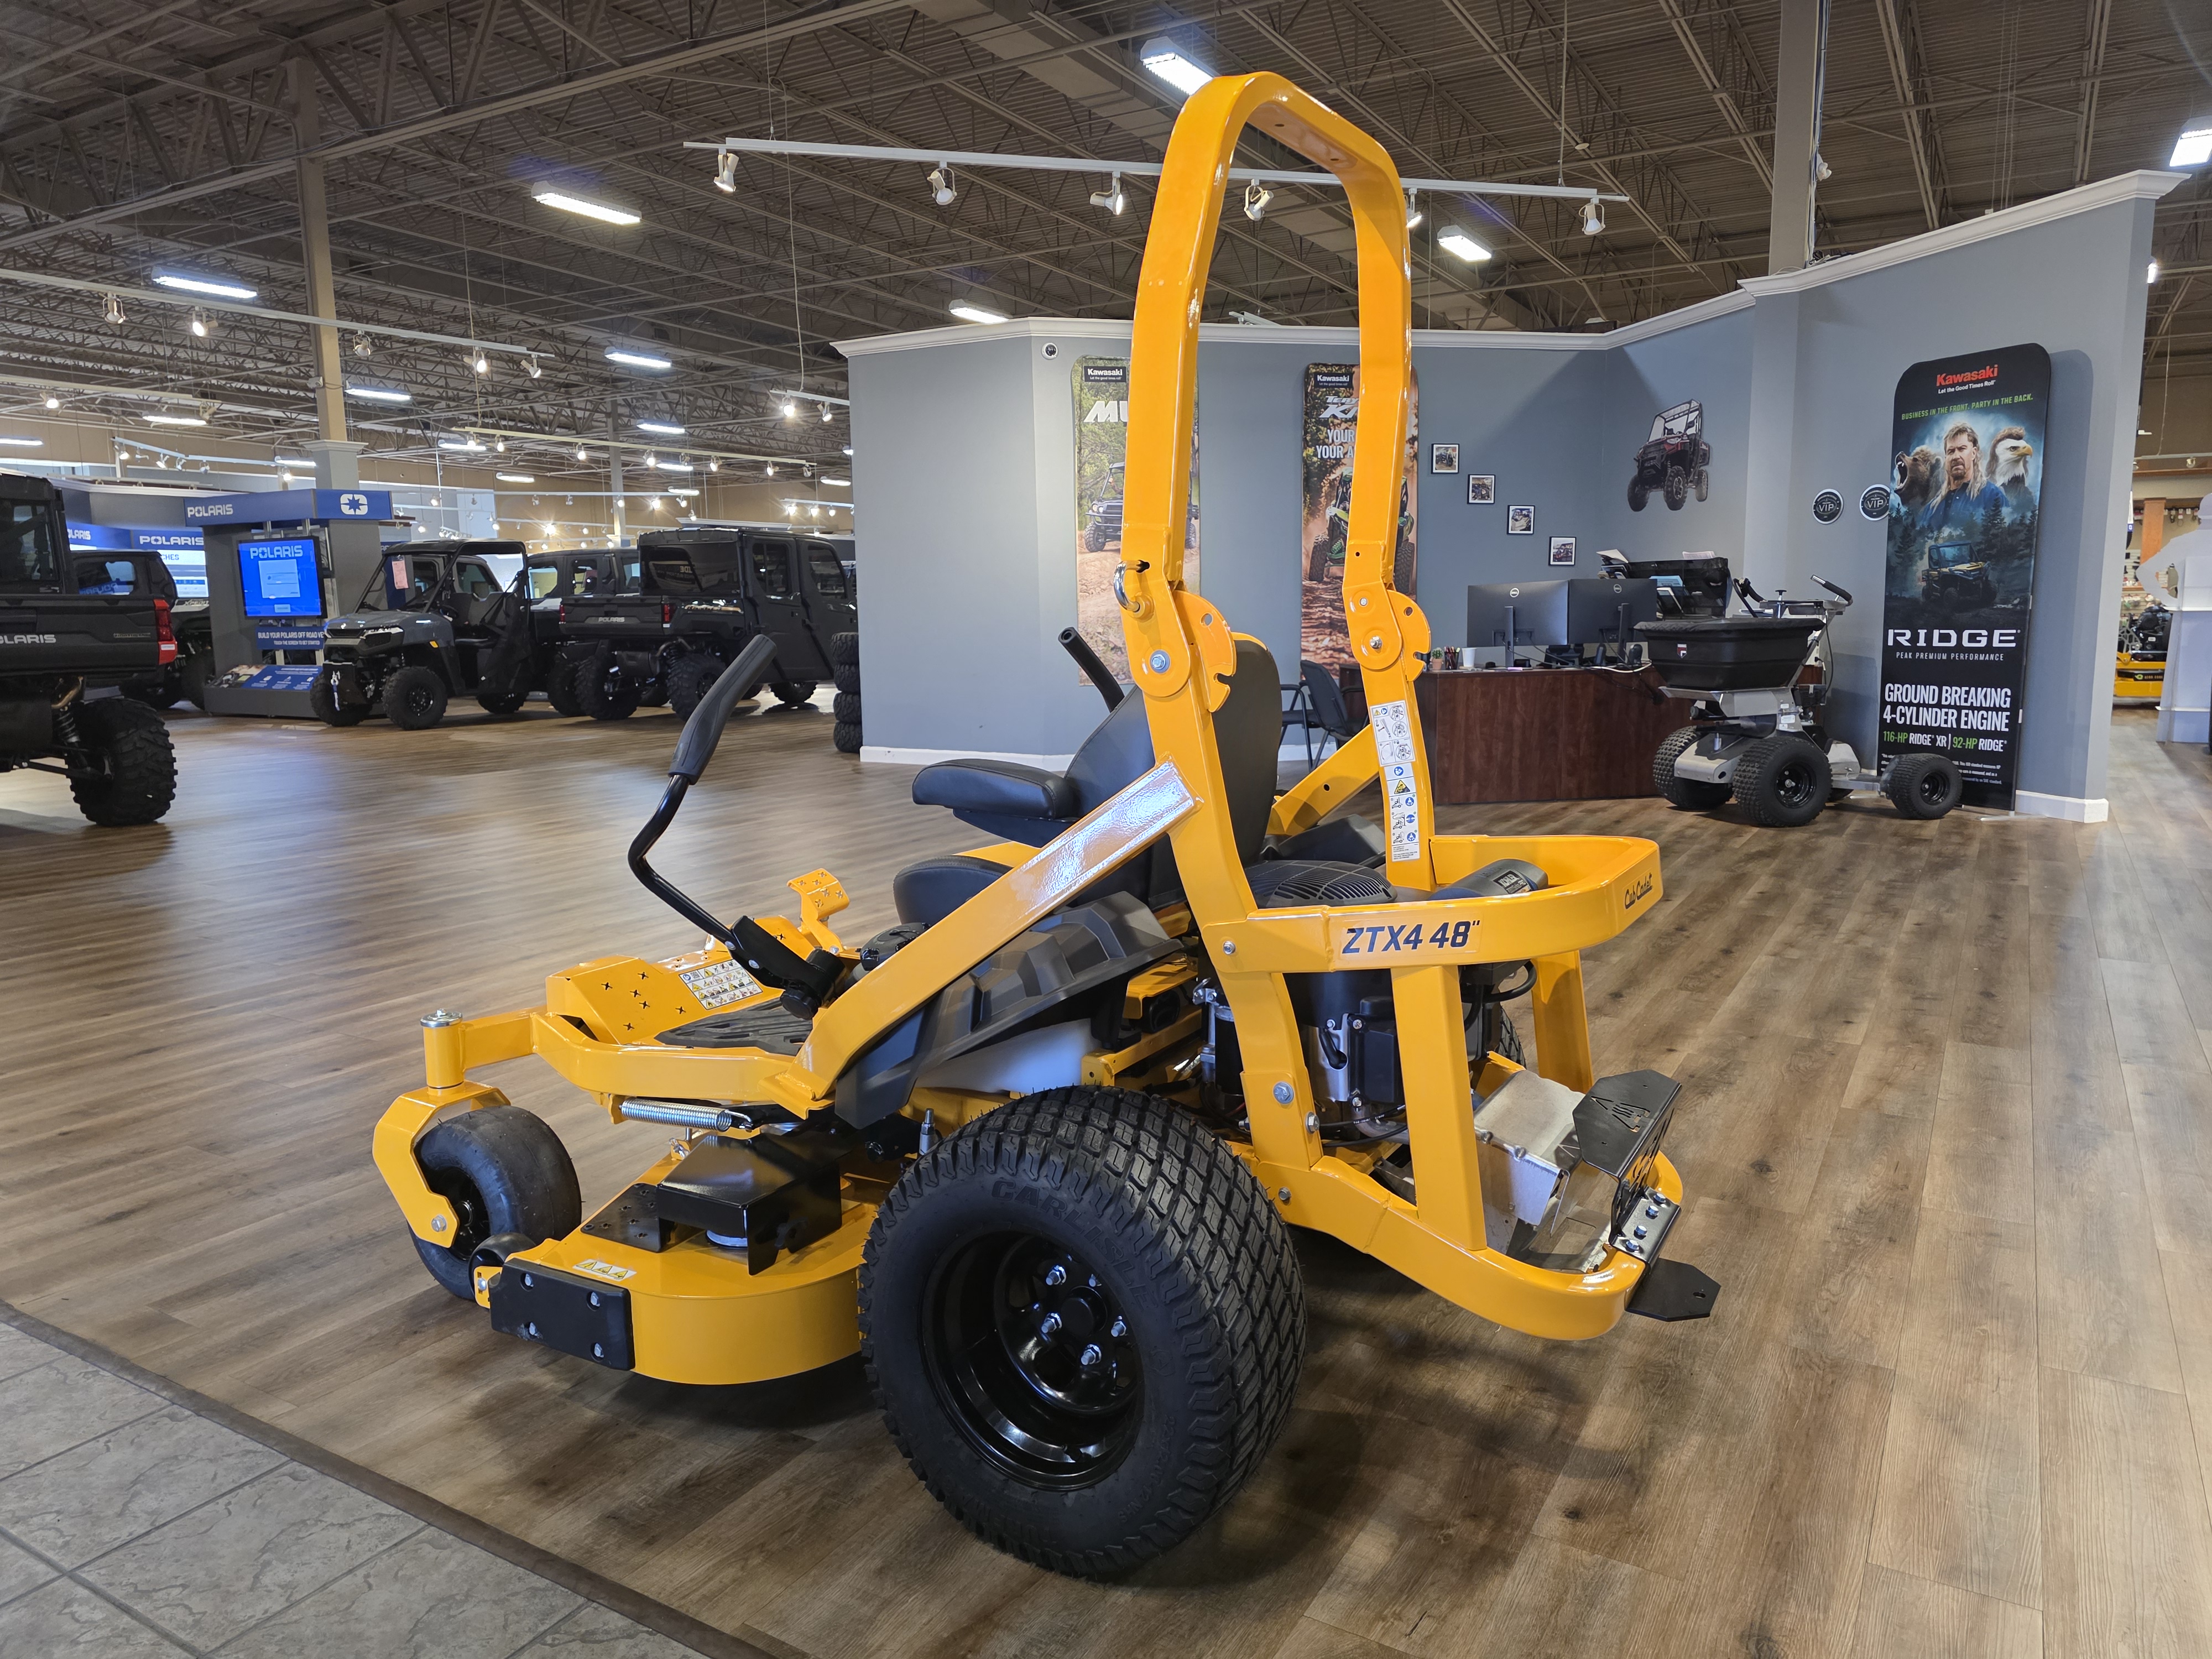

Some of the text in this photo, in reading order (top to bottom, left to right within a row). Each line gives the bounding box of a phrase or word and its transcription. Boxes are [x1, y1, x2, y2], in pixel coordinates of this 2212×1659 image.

[1937, 364, 1999, 387] Kawasaki
[1901, 409, 1928, 420] BUSINESS
[1949, 403, 1969, 412] FRONT.
[1971, 400, 1991, 409] PARTY
[2014, 393, 2033, 403] BACK.
[1327, 429, 1355, 442] YOUR
[1316, 445, 1344, 458] YOUR
[187, 504, 233, 518] POLARIS
[1867, 500, 1884, 508] VIP
[139, 536, 204, 545] POLARIS
[250, 545, 303, 559] POLARIS
[0, 634, 56, 644] LARIS
[1887, 629, 2017, 647] RIDGE
[1885, 683, 2011, 708] GROUND BREAKING
[1883, 705, 2010, 732] 4-CYLINDER ENGINE
[1883, 731, 1908, 743] 116-HP
[1953, 737, 1978, 749] 92-HP
[1342, 920, 1480, 954] ZTX4 48"
[992, 1180, 1159, 1311] CARLISLE
